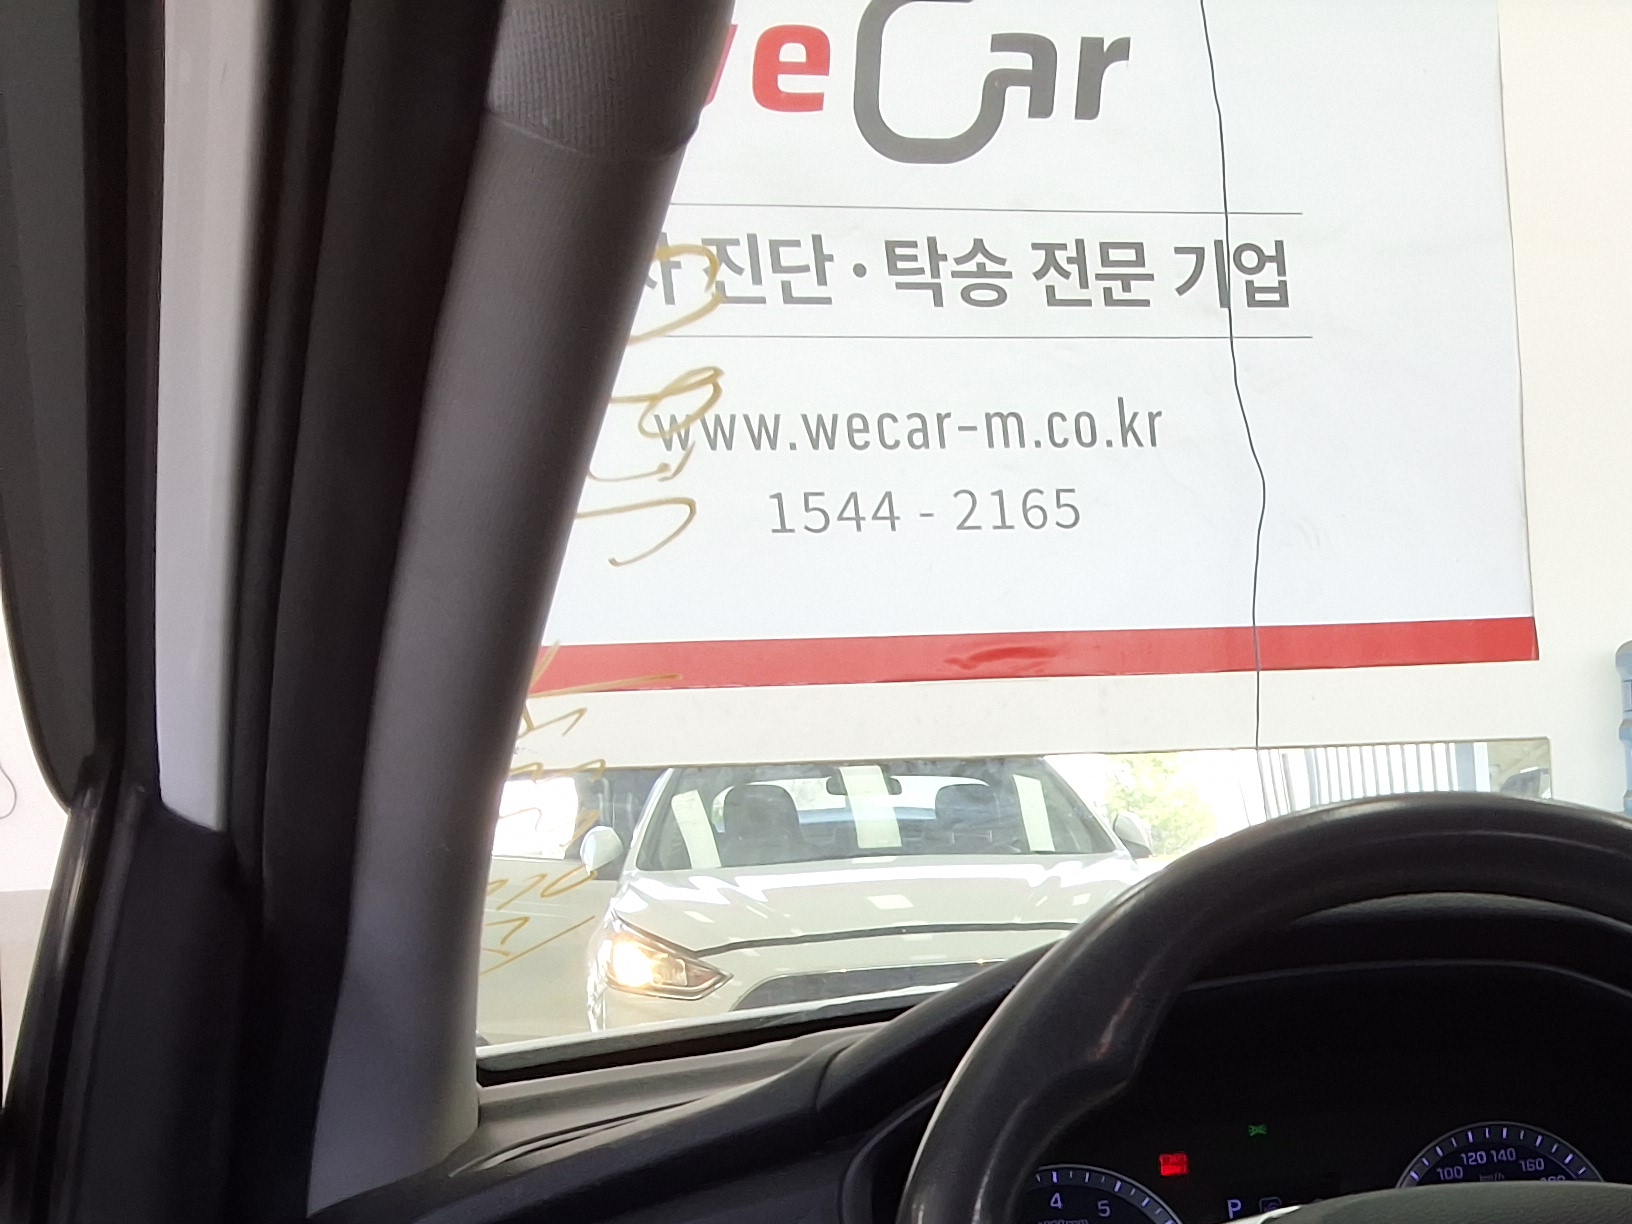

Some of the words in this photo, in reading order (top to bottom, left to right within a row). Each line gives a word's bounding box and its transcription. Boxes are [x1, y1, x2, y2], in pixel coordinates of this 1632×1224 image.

[706, 0, 1131, 164] eCar
[1031, 238, 1155, 307] 전문
[1174, 239, 1290, 308] 기업
[654, 396, 1163, 451] www.wecar-m.co.kr
[1460, 1151, 1487, 1166] 120
[1490, 1147, 1517, 1163] 140
[1436, 1165, 1464, 1181] 100
[1519, 1158, 1545, 1172] 160
[1050, 1192, 1063, 1209] 4
[1098, 1200, 1111, 1217] 5
[1227, 1199, 1242, 1219] P
